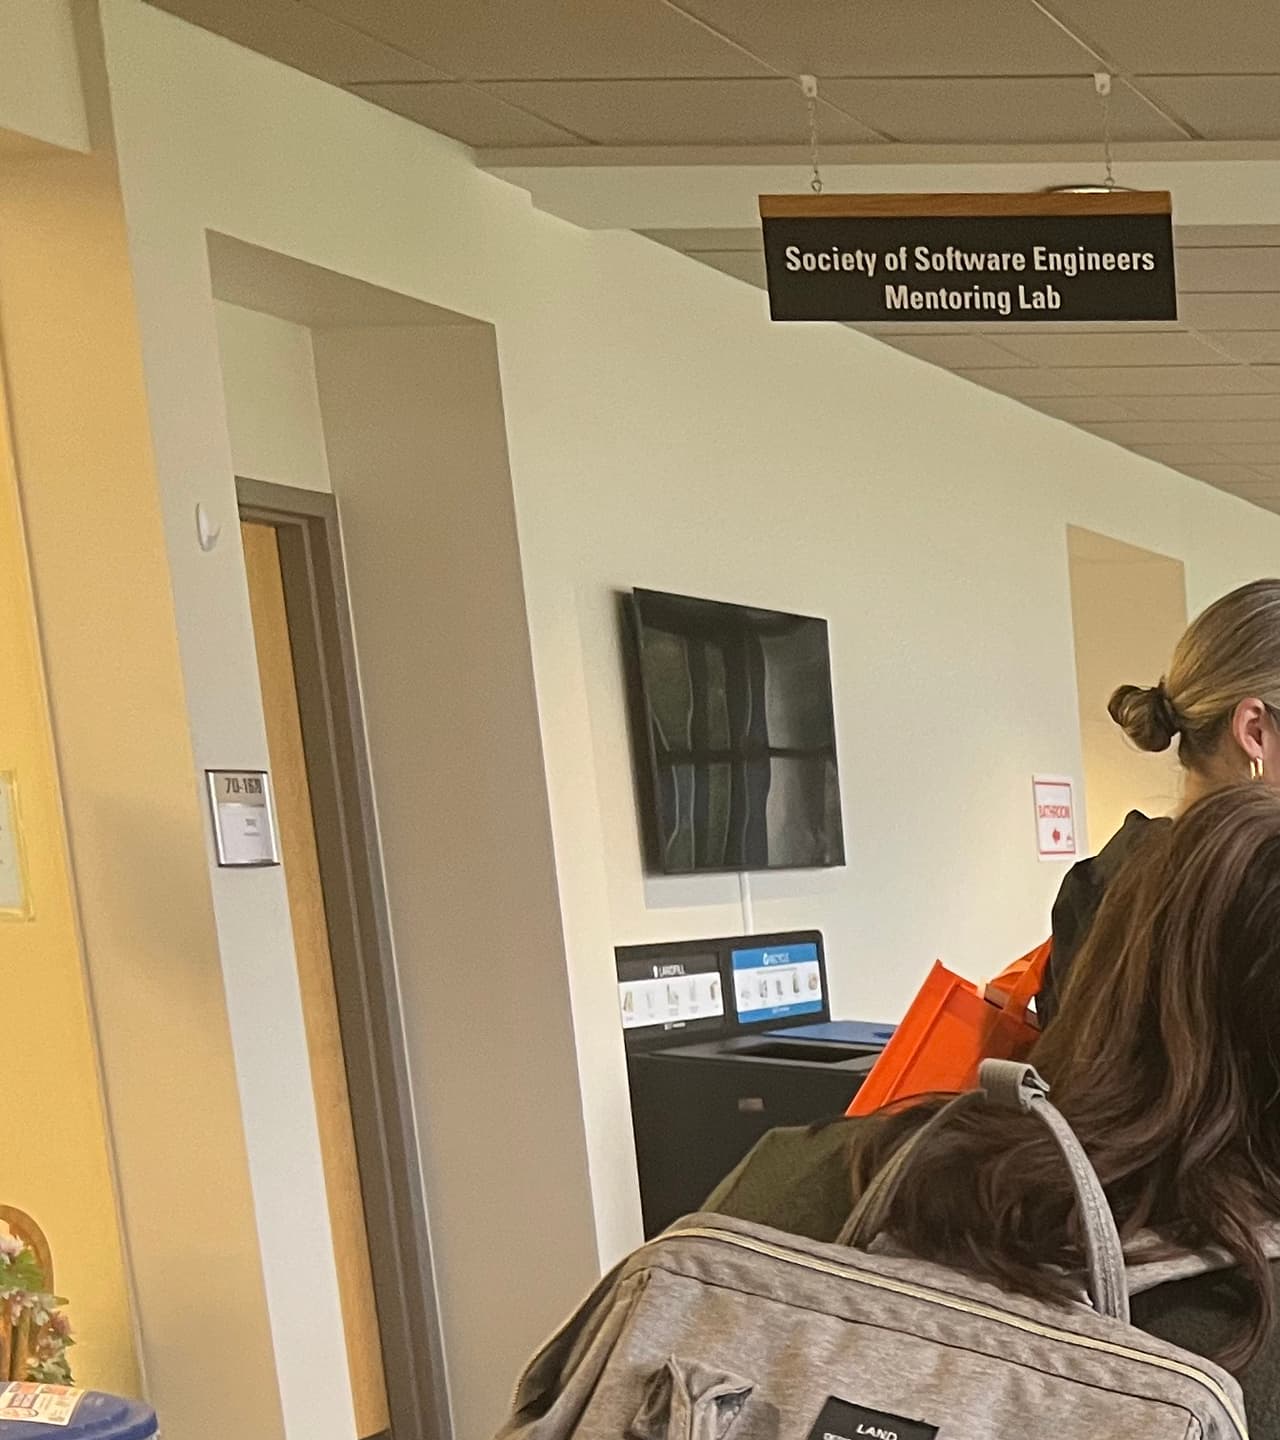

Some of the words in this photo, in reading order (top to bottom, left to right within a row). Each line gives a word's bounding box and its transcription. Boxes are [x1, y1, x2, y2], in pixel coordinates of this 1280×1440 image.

[785, 246, 877, 277] Society
[884, 246, 908, 271] of
[914, 246, 1026, 271] Software
[1033, 246, 1155, 276] Engineers
[885, 284, 1012, 315] Mentoring
[1018, 284, 1061, 310] Lab
